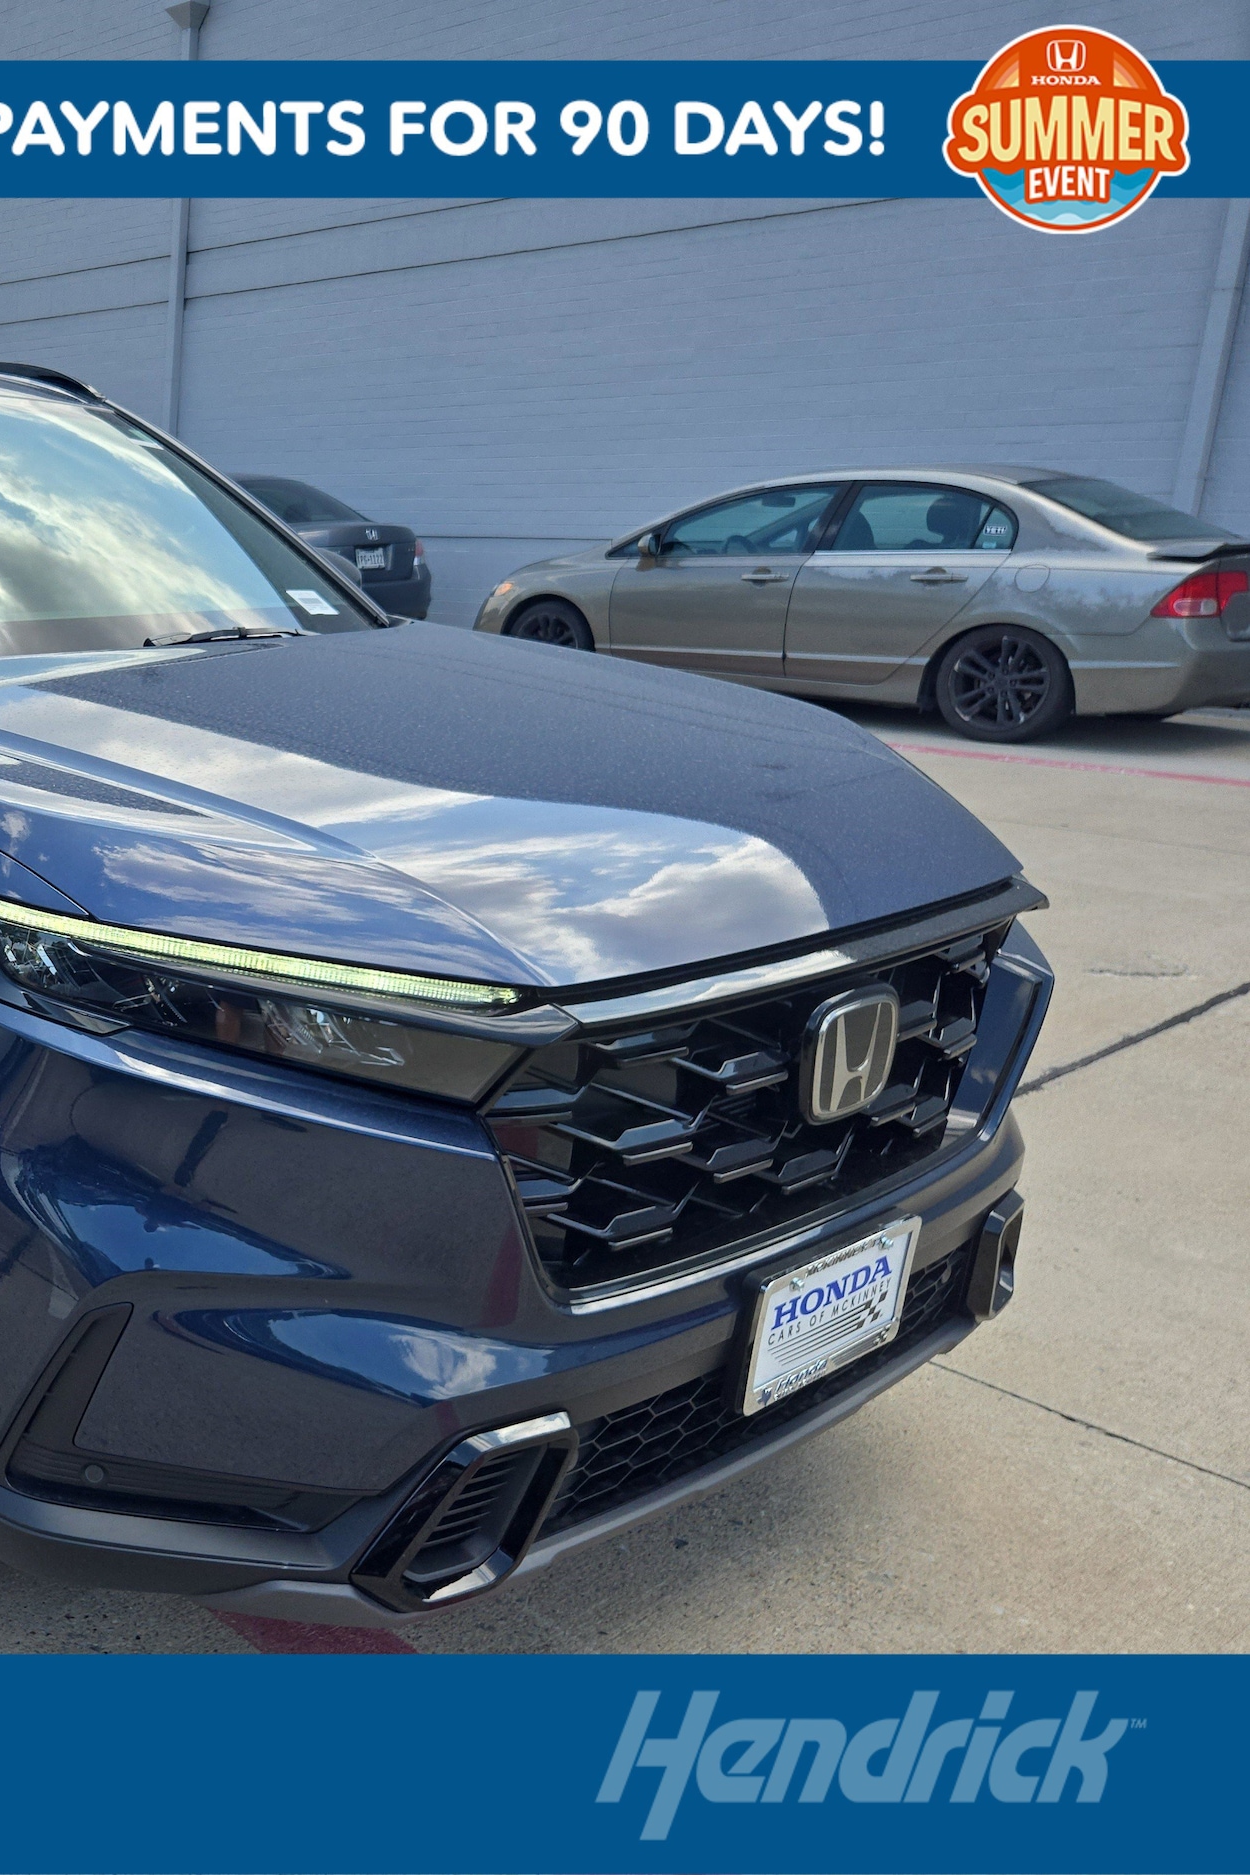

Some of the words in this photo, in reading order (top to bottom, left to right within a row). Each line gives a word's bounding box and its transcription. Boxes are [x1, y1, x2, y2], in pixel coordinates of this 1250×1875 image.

[770, 1255, 893, 1331] HONDA
[767, 1320, 802, 1346] CARS
[809, 1310, 825, 1328] OF
